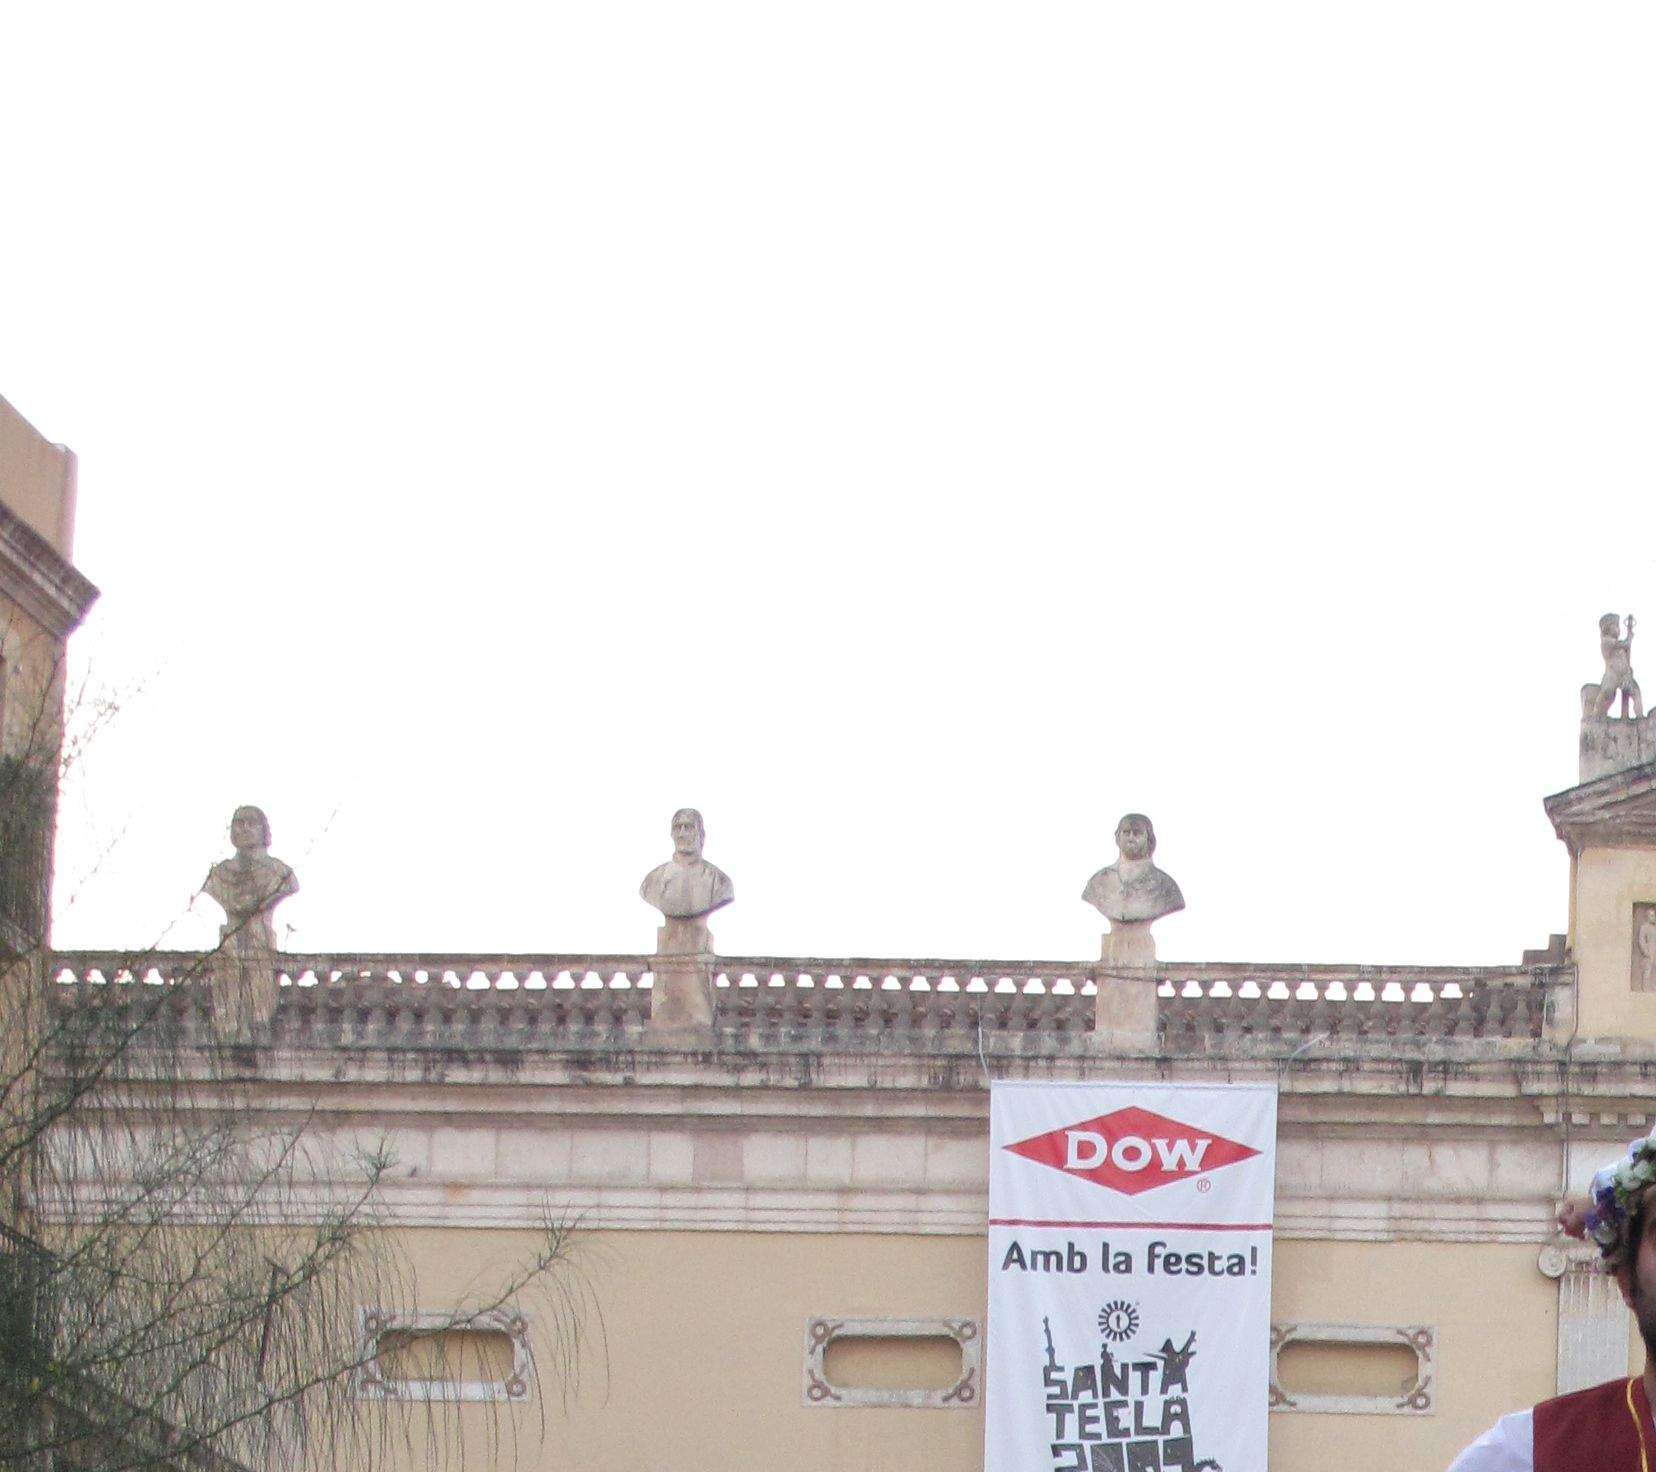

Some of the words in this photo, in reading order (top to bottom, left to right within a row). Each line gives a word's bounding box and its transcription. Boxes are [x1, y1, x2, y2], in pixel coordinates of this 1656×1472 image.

[1001, 1240, 1088, 1274] Amb
[1101, 1243, 1133, 1275] la
[1146, 1242, 1259, 1277] festa!
[1043, 1352, 1190, 1401] SANTA
[1046, 1396, 1191, 1441] TECLA
